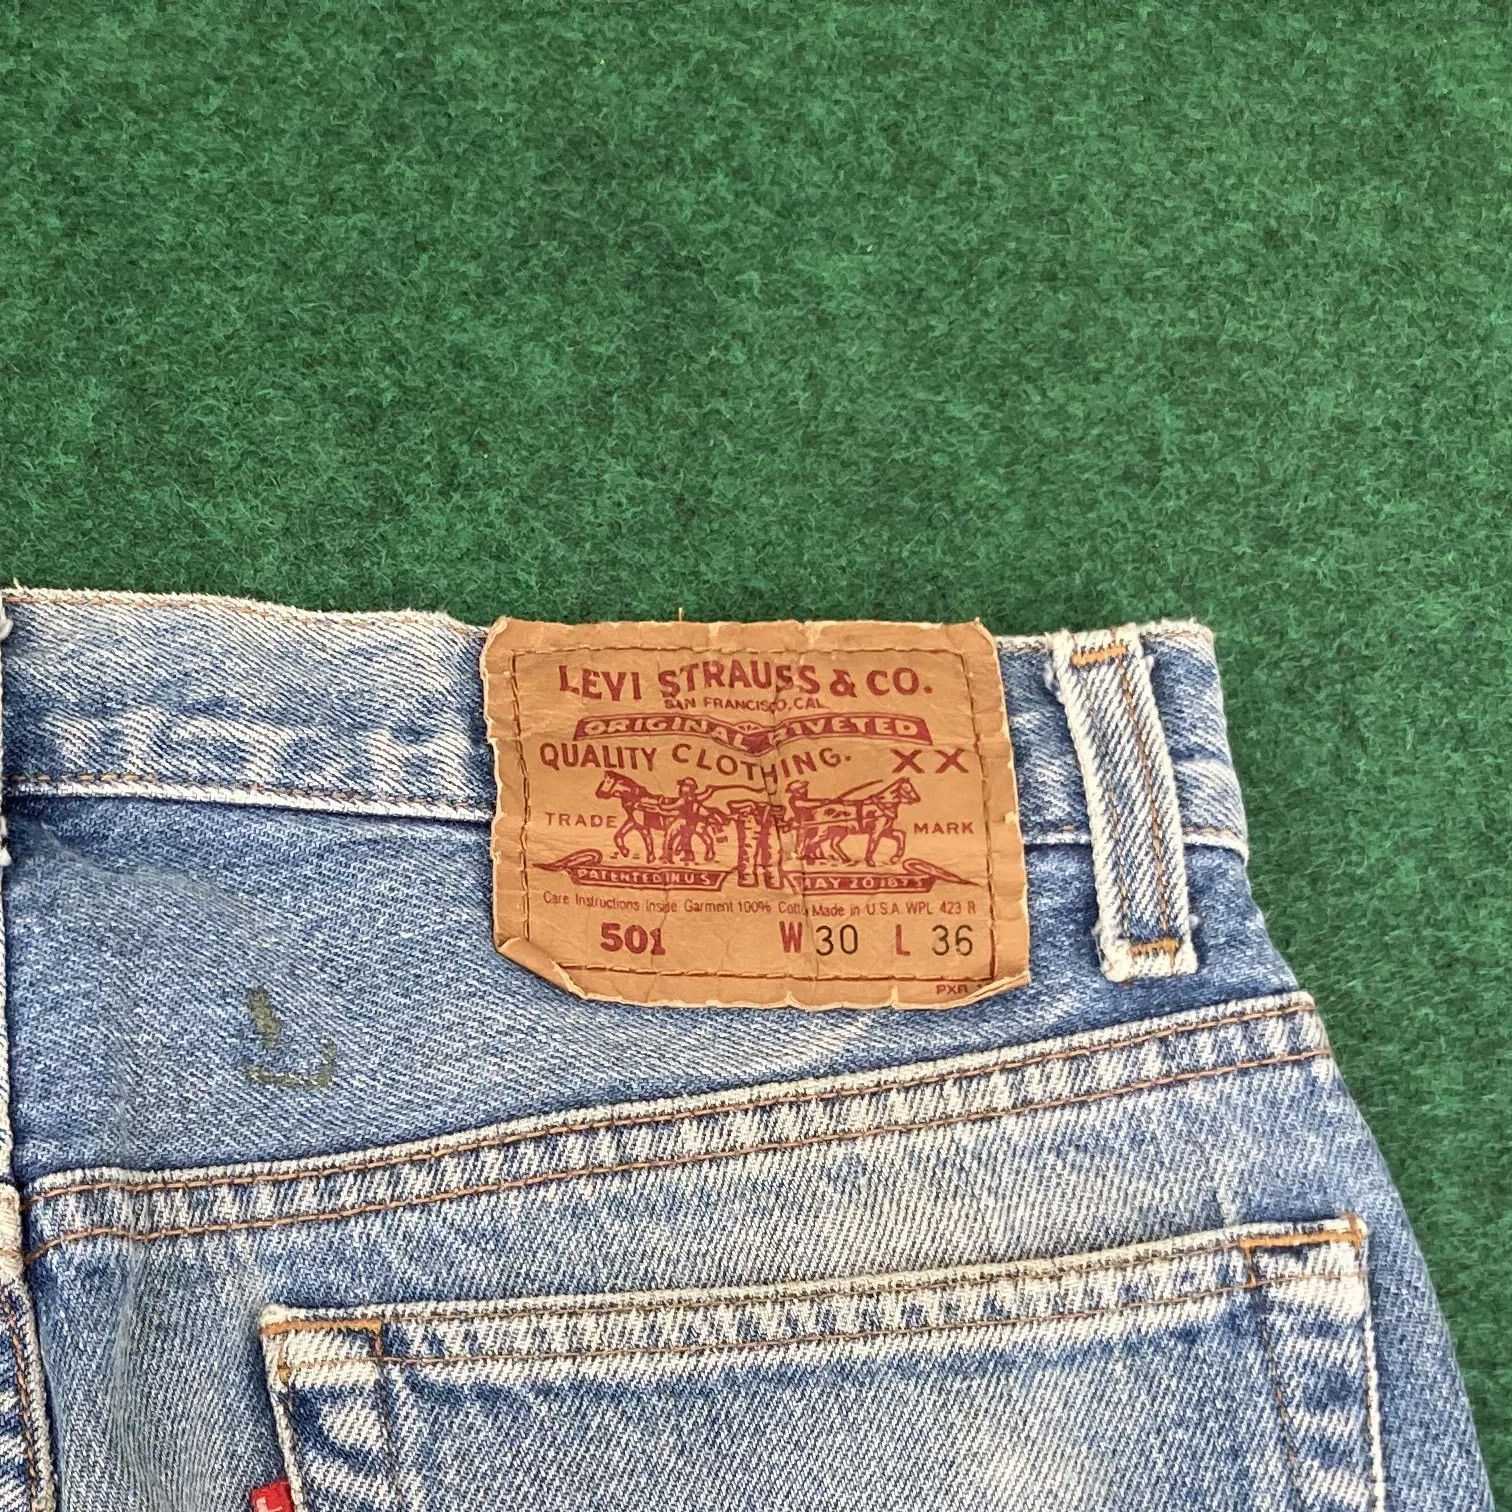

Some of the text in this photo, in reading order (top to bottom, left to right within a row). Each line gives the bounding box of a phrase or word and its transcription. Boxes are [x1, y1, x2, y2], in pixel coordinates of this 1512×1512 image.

[557, 659, 934, 702] LEVI STRAUSS & CO.
[664, 697, 696, 710] SAN
[583, 716, 920, 752] ORIGINAL RIVETED
[539, 742, 657, 772] QUALITY
[545, 811, 618, 829] TRADE
[913, 821, 975, 836] MARK
[577, 868, 664, 884] PATENTED
[849, 876, 875, 890] 20
[542, 890, 570, 906] Care
[575, 893, 640, 912] Instructions
[646, 900, 678, 914] Inside
[683, 900, 734, 914] Garment
[737, 900, 772, 914] 100%
[778, 900, 807, 916] Cott
[811, 903, 845, 917] Made
[849, 903, 861, 917] in
[905, 900, 934, 916] WPL
[939, 900, 962, 915] 423
[966, 900, 977, 915] R
[599, 920, 974, 957] 501 W 30 L 36
